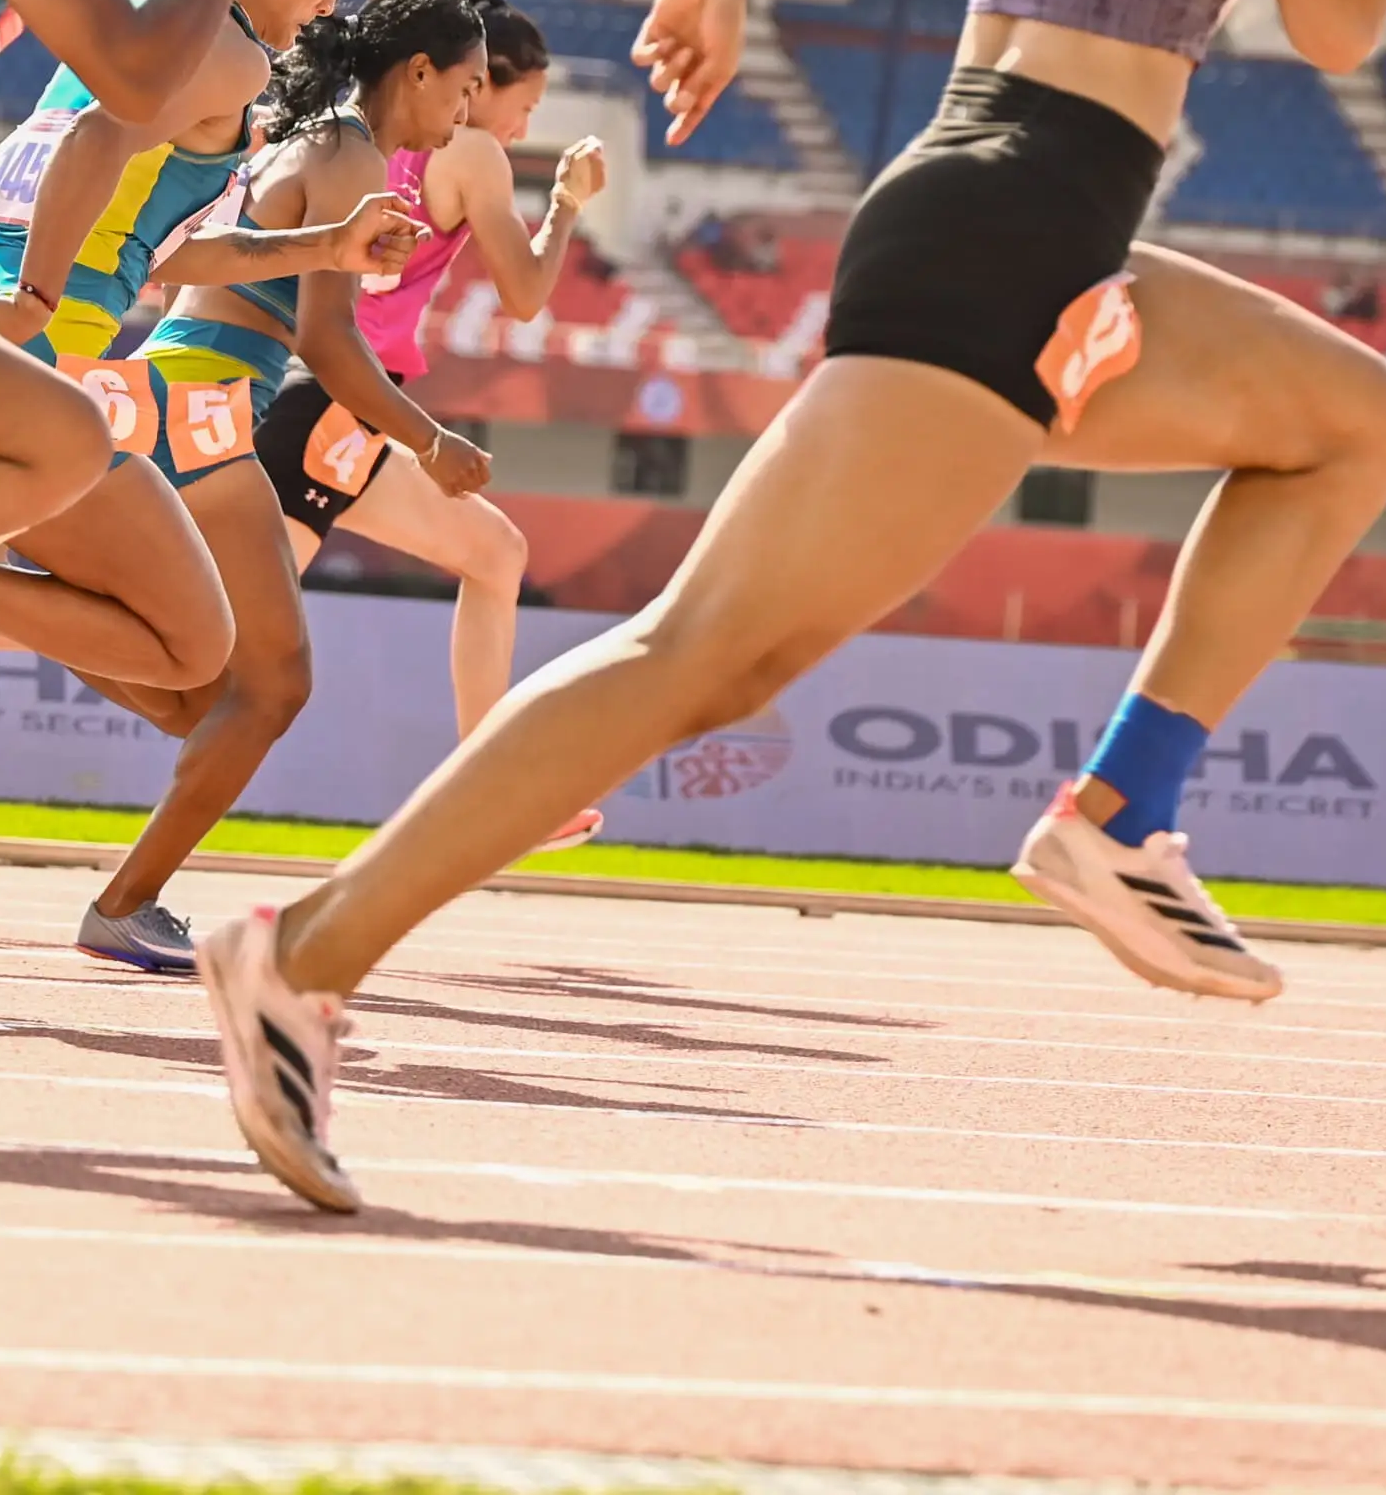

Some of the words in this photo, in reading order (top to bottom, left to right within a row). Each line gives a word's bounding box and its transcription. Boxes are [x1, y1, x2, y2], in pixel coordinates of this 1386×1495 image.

[81, 369, 138, 442] 6
[187, 389, 237, 456] 5
[322, 428, 367, 485] 4
[826, 705, 1380, 791] ODIHA
[833, 767, 996, 799] INDIA'S
[1228, 790, 1374, 820] SECRET
